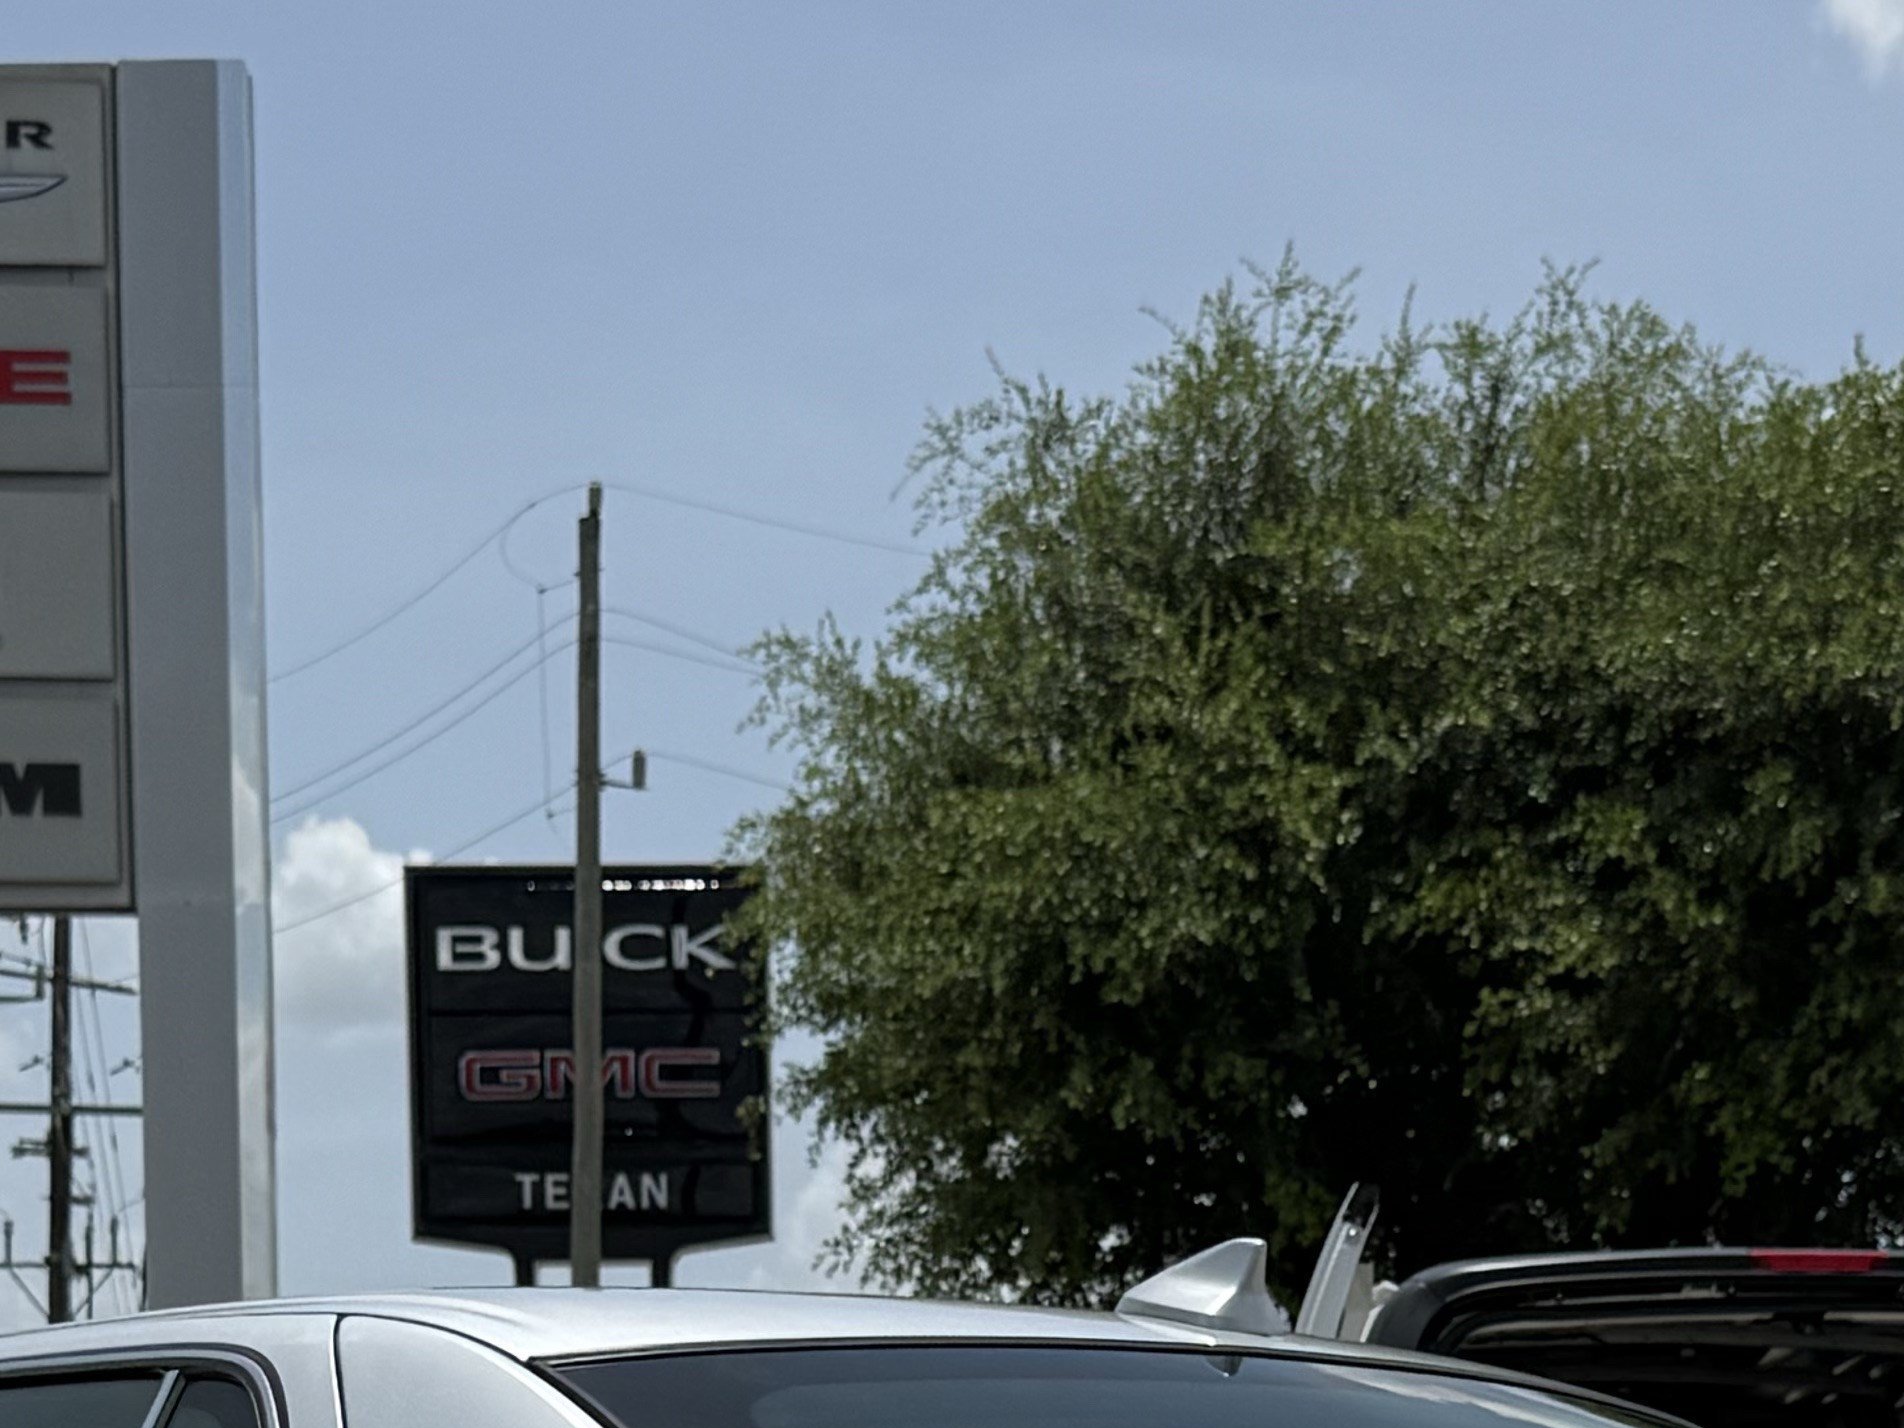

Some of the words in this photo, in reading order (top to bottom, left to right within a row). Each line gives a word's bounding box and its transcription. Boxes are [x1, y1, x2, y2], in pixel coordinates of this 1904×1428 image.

[436, 924, 737, 972] BUCK
[458, 1047, 722, 1102] GMC
[514, 1172, 670, 1210] TEAN
